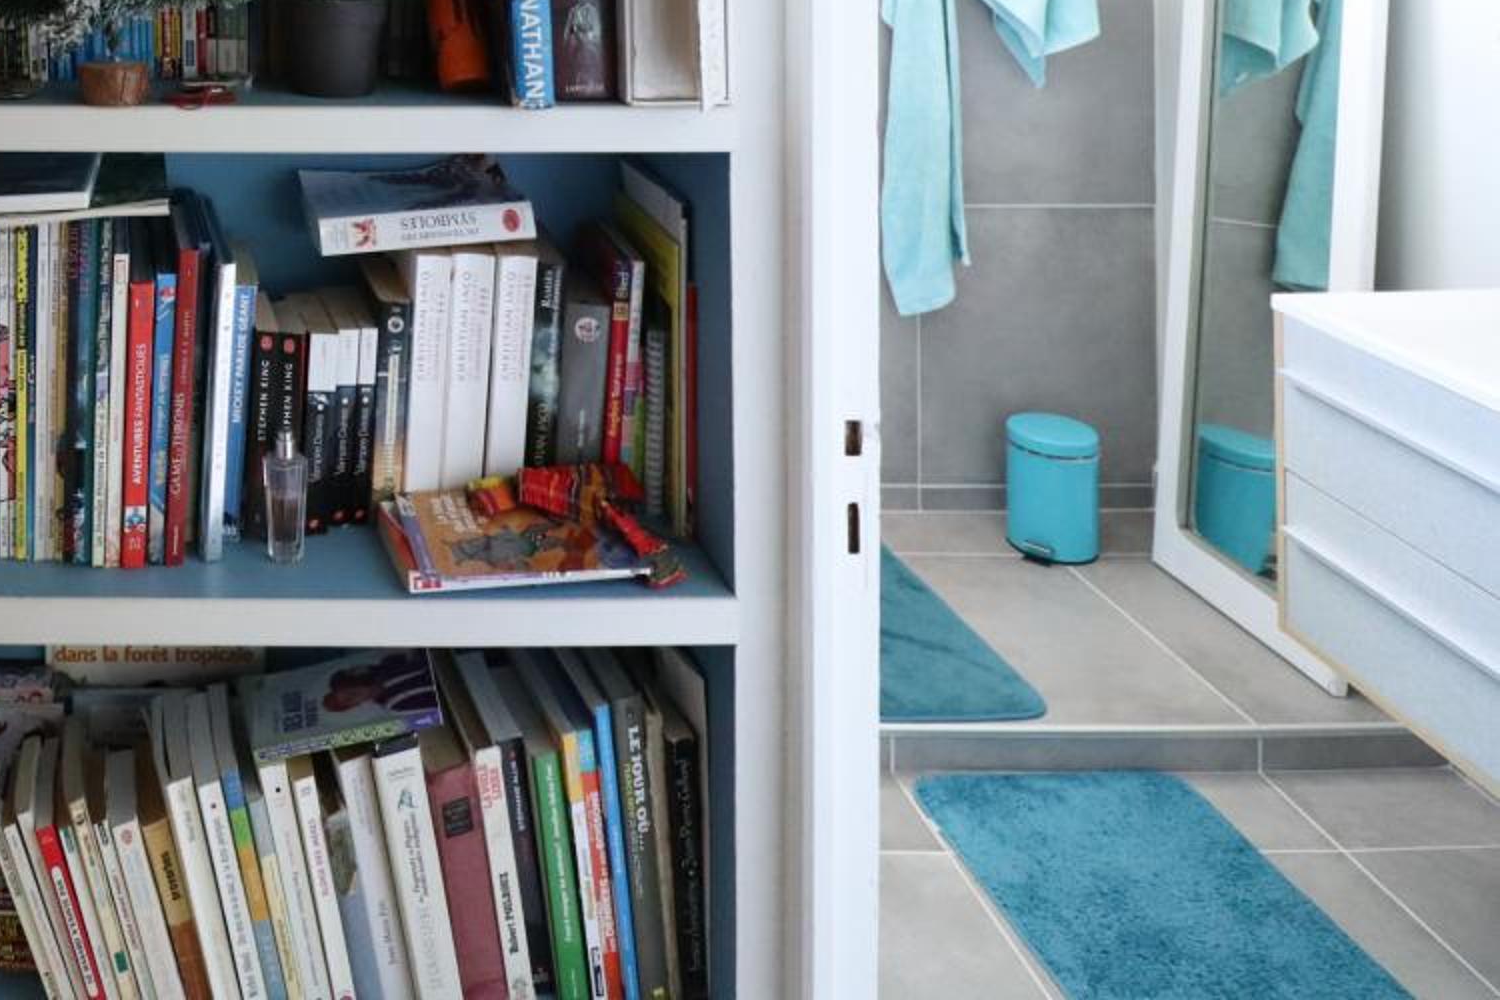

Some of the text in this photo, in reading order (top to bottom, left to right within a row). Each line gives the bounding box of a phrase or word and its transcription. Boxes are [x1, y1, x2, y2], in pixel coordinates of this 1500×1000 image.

[402, 211, 478, 230] SYMBOLES
[457, 309, 468, 381] CHRISTIAN
[284, 364, 293, 390] KING
[131, 344, 147, 484] AVENTURES FANTASTIQUES
[257, 360, 270, 441] STEPHEN KING
[172, 457, 181, 495] GAME
[55, 646, 97, 662] dans
[102, 646, 118, 662] la
[123, 646, 168, 662] forêt
